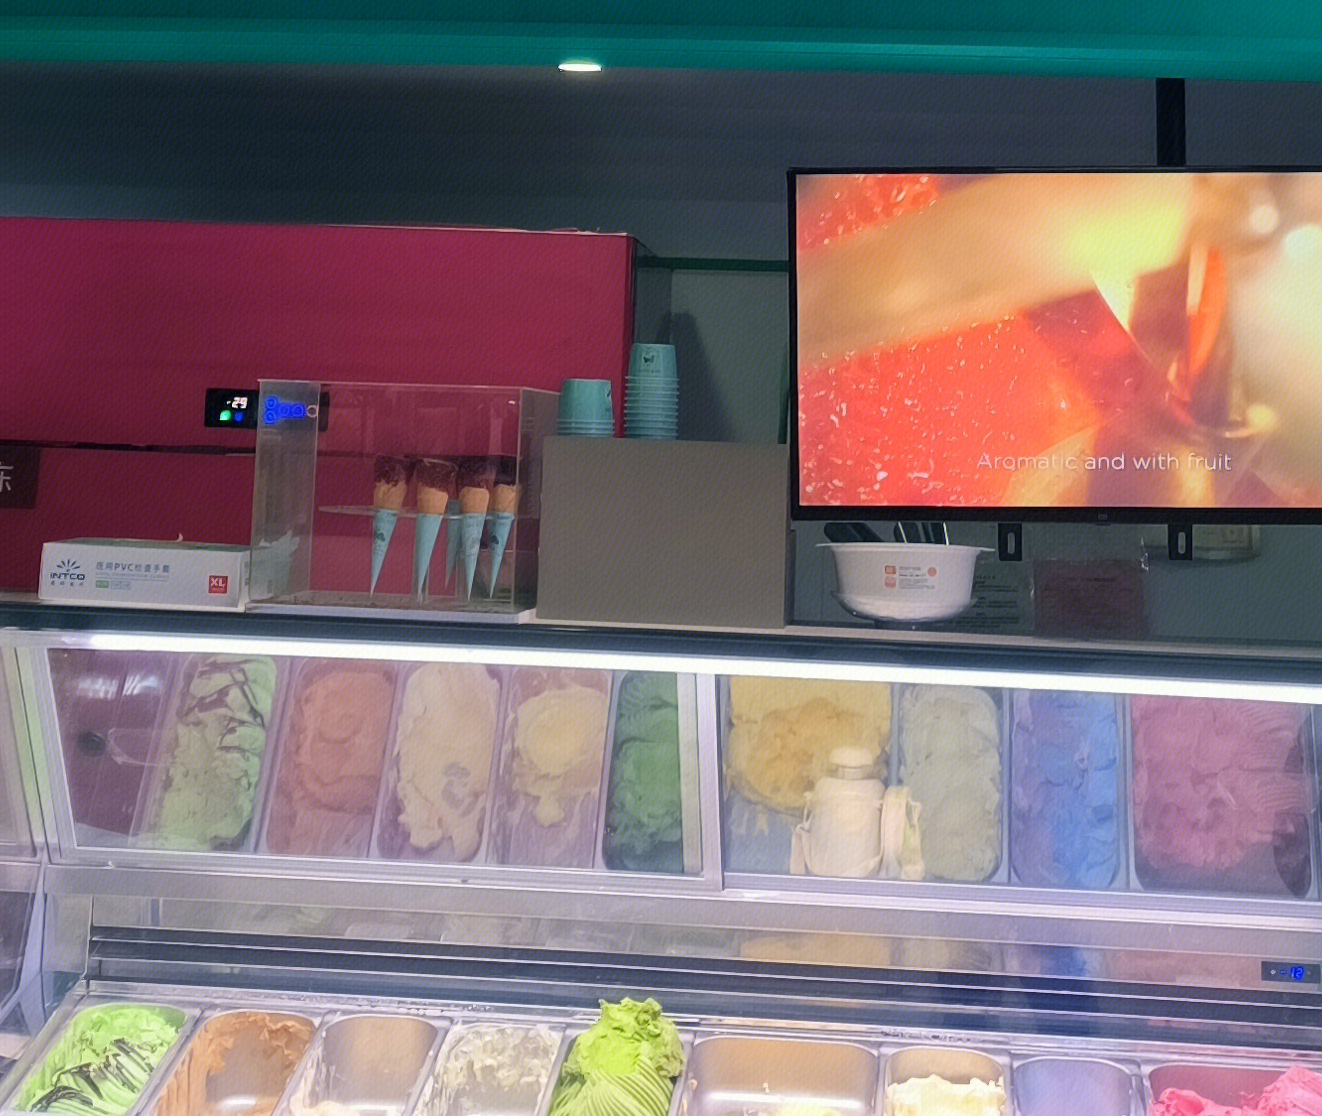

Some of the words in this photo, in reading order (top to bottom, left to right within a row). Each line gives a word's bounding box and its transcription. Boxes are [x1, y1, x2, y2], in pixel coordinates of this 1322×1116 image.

[977, 452, 1077, 471] Aromatic
[1084, 452, 1125, 471] and
[1133, 452, 1179, 471] with
[1187, 452, 1233, 471] fruit
[210, 577, 226, 588] XL
